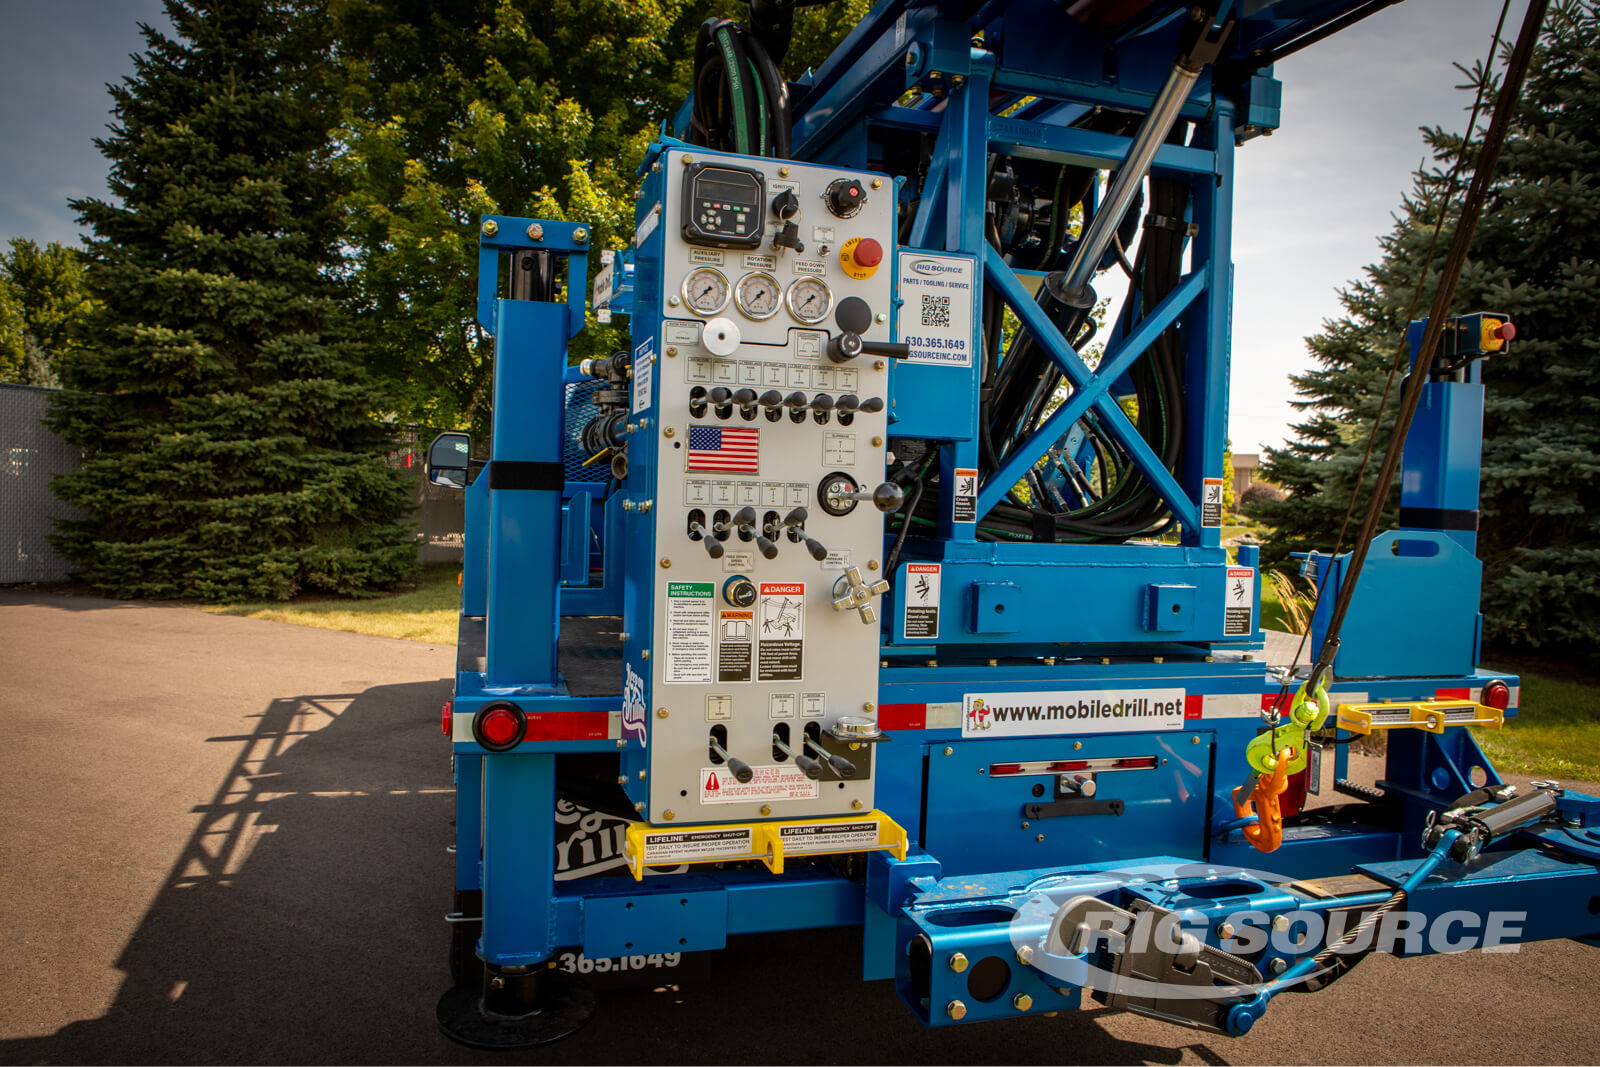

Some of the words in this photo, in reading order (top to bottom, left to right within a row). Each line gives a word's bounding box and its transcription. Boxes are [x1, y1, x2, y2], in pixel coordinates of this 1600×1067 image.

[693, 249, 720, 257] AUXILIARY
[916, 263, 930, 271] RIG
[931, 265, 963, 274] SOURCE
[923, 279, 945, 288] TOOLING
[948, 281, 969, 290] SERVICE
[905, 336, 965, 350] 630.365.1649
[770, 585, 801, 594] DANGER
[993, 698, 1183, 722] www.mobiledrill.net
[721, 839, 750, 847] OPERATION
